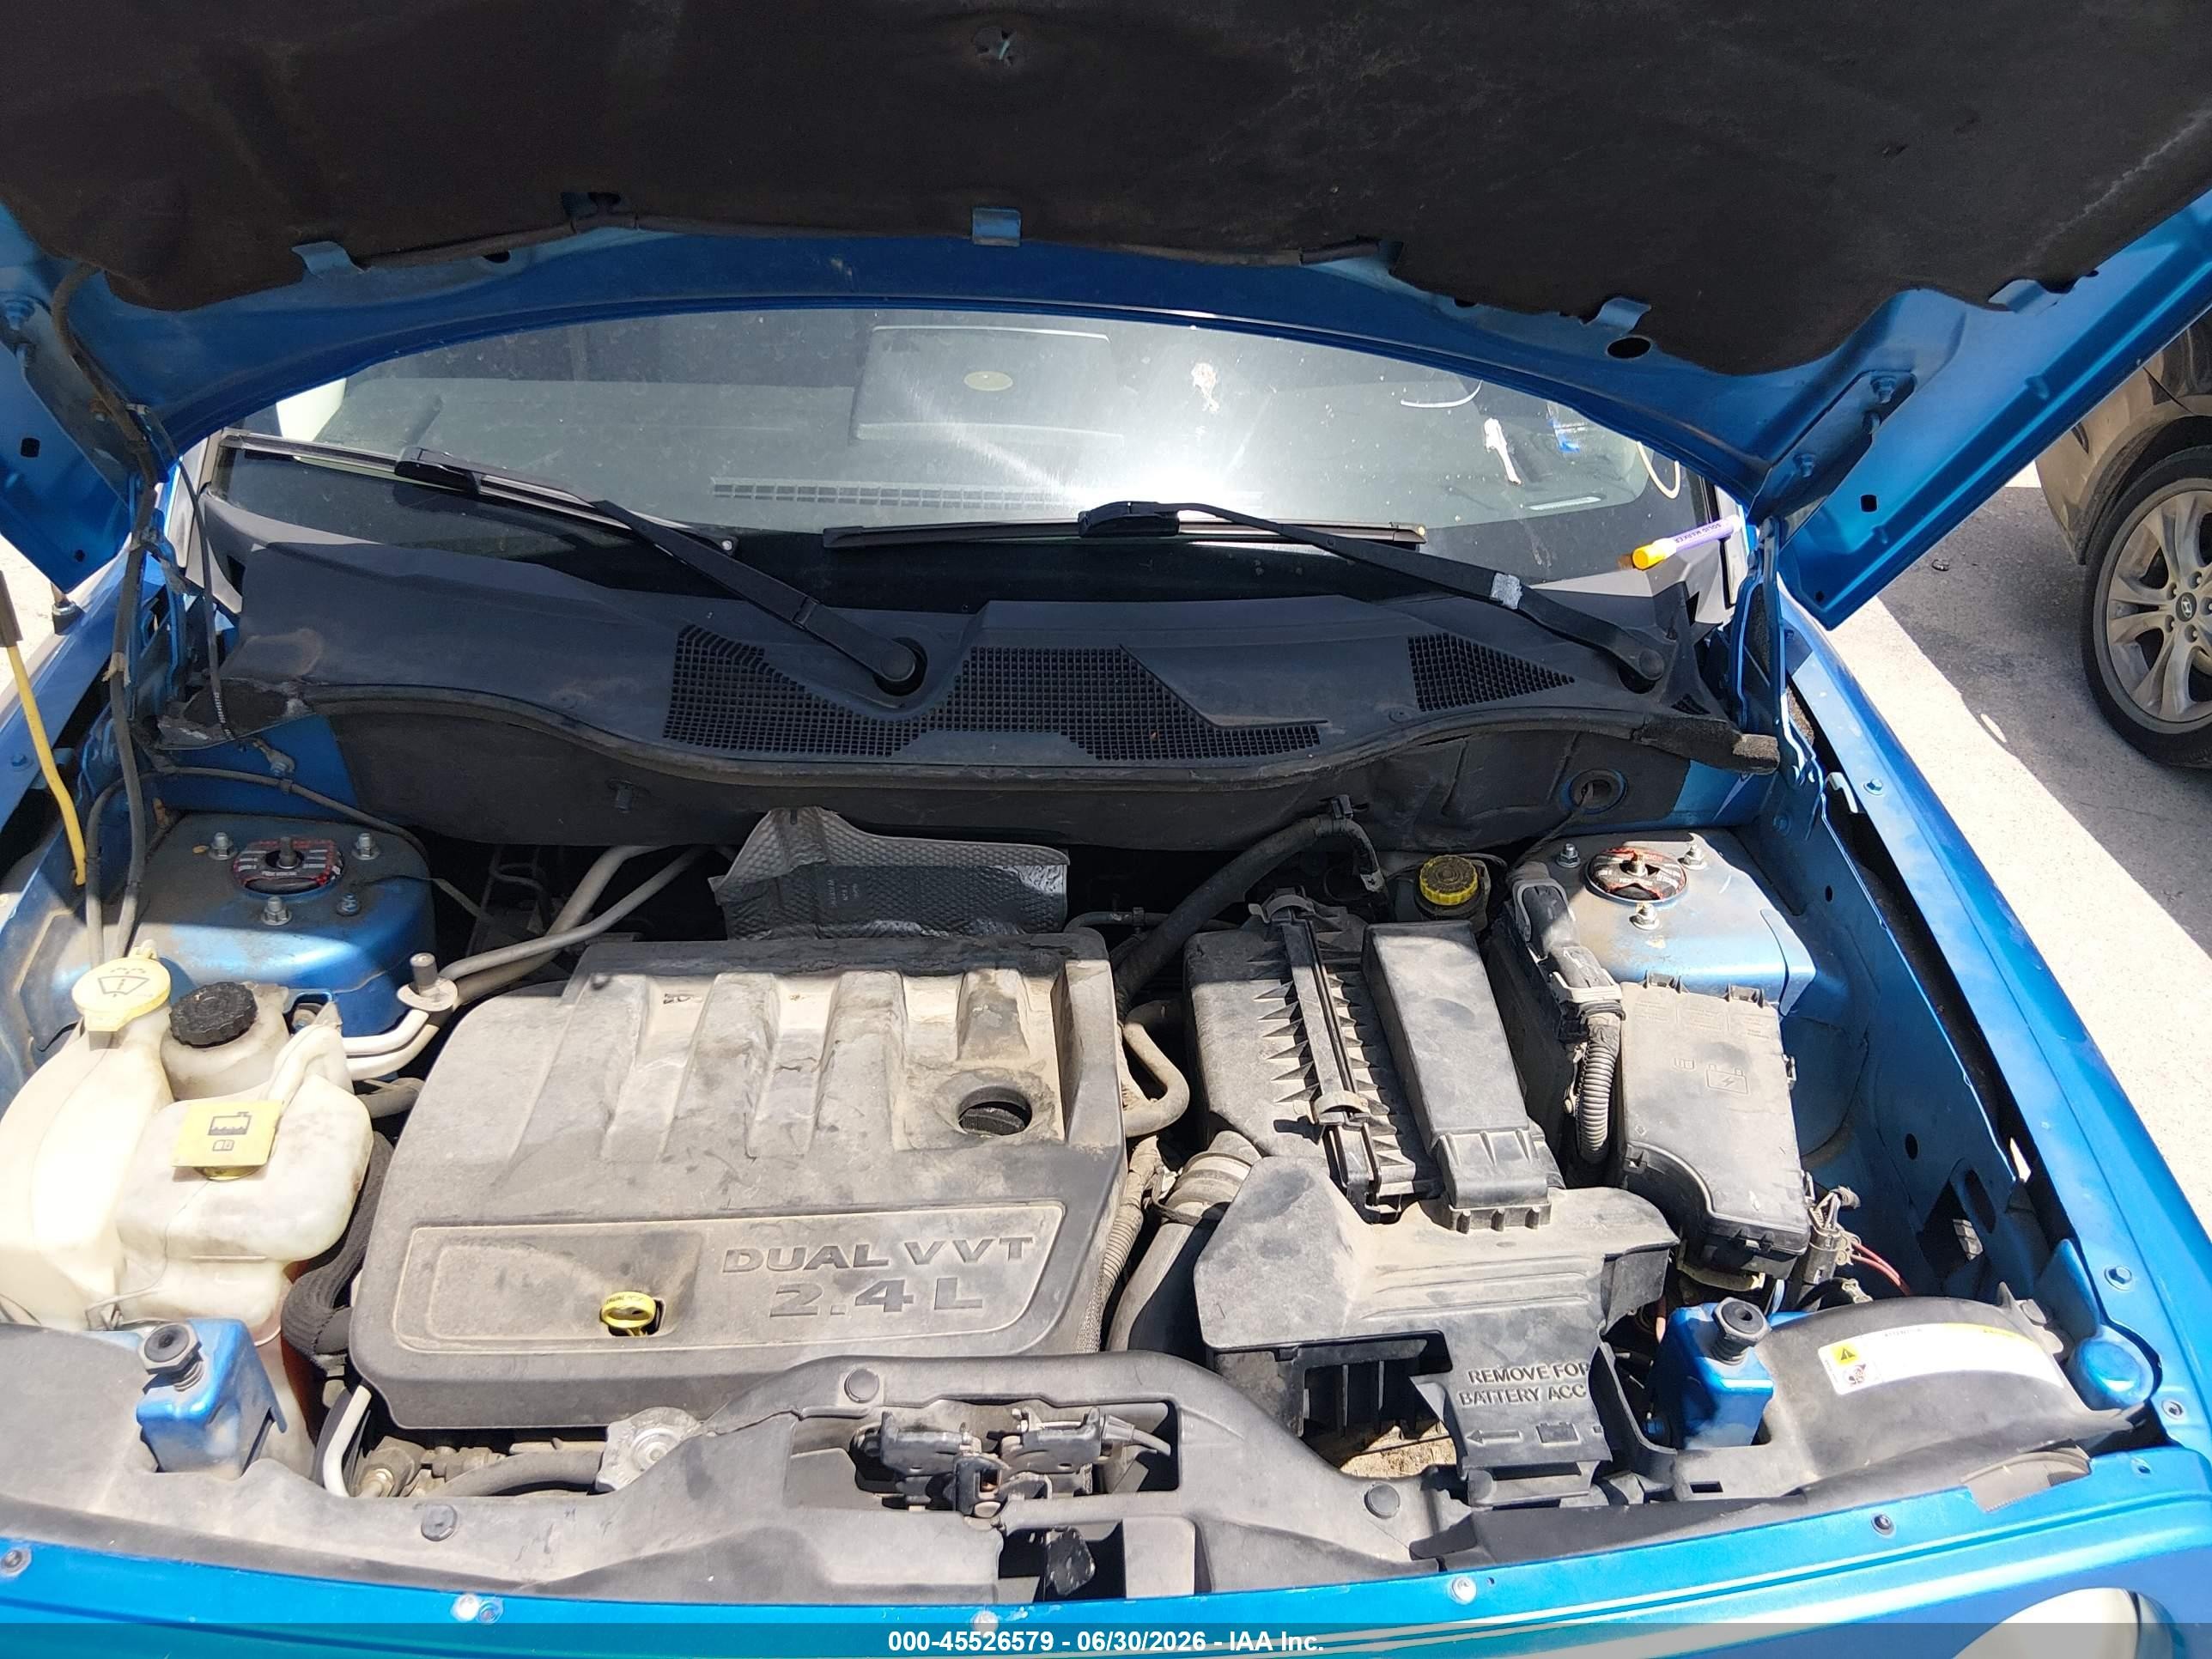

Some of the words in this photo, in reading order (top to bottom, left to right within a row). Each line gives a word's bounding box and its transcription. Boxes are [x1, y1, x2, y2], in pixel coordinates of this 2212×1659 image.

[722, 1243, 890, 1273] DUAL
[903, 1236, 1034, 1266] VVT
[1468, 1364, 1550, 1384] REMOVE
[1459, 1386, 1540, 1406] BATTERY
[1548, 1383, 1587, 1401] ACC
